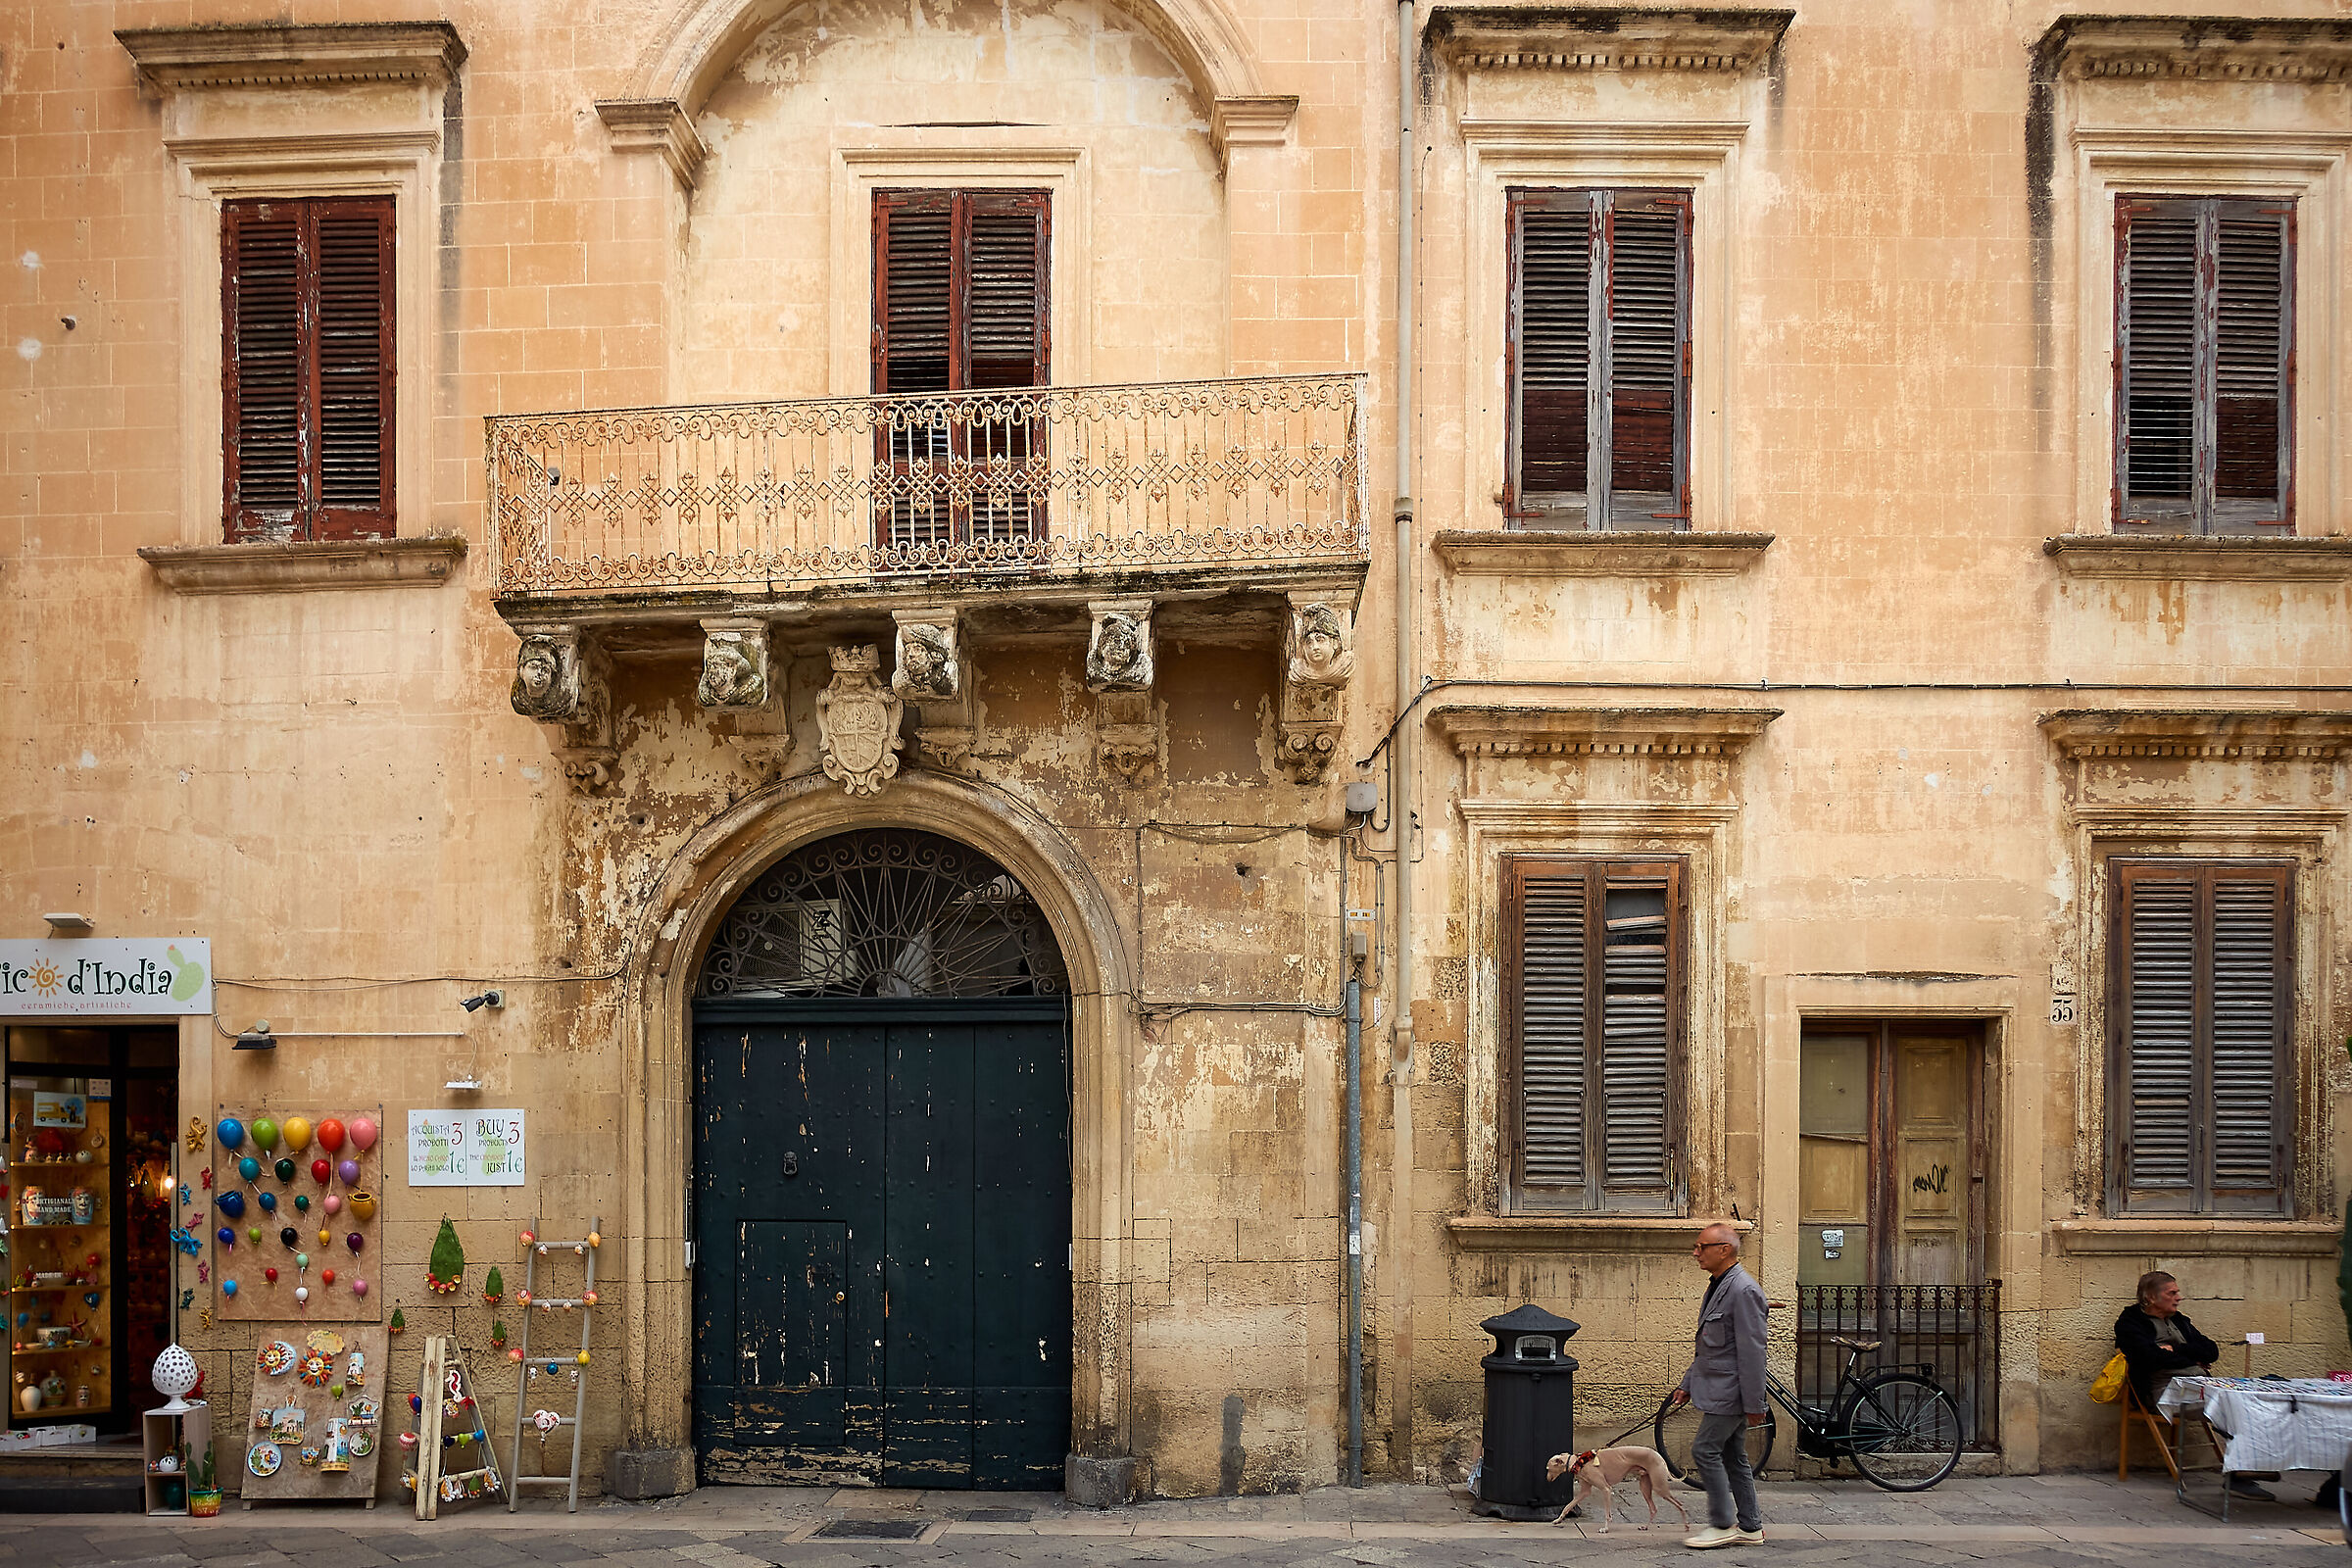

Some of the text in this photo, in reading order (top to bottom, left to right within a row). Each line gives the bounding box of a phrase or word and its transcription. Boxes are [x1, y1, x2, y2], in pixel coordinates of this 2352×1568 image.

[68, 958, 172, 995] d'India
[79, 1001, 132, 1009] artistiche
[2052, 999, 2073, 1022] 35
[411, 1122, 464, 1146] ACQUISTA 3
[475, 1118, 520, 1145] BUY 3
[417, 1139, 449, 1148] PRODOTTI
[478, 1139, 509, 1148] PRODUCTS
[486, 1162, 508, 1174] JUST
